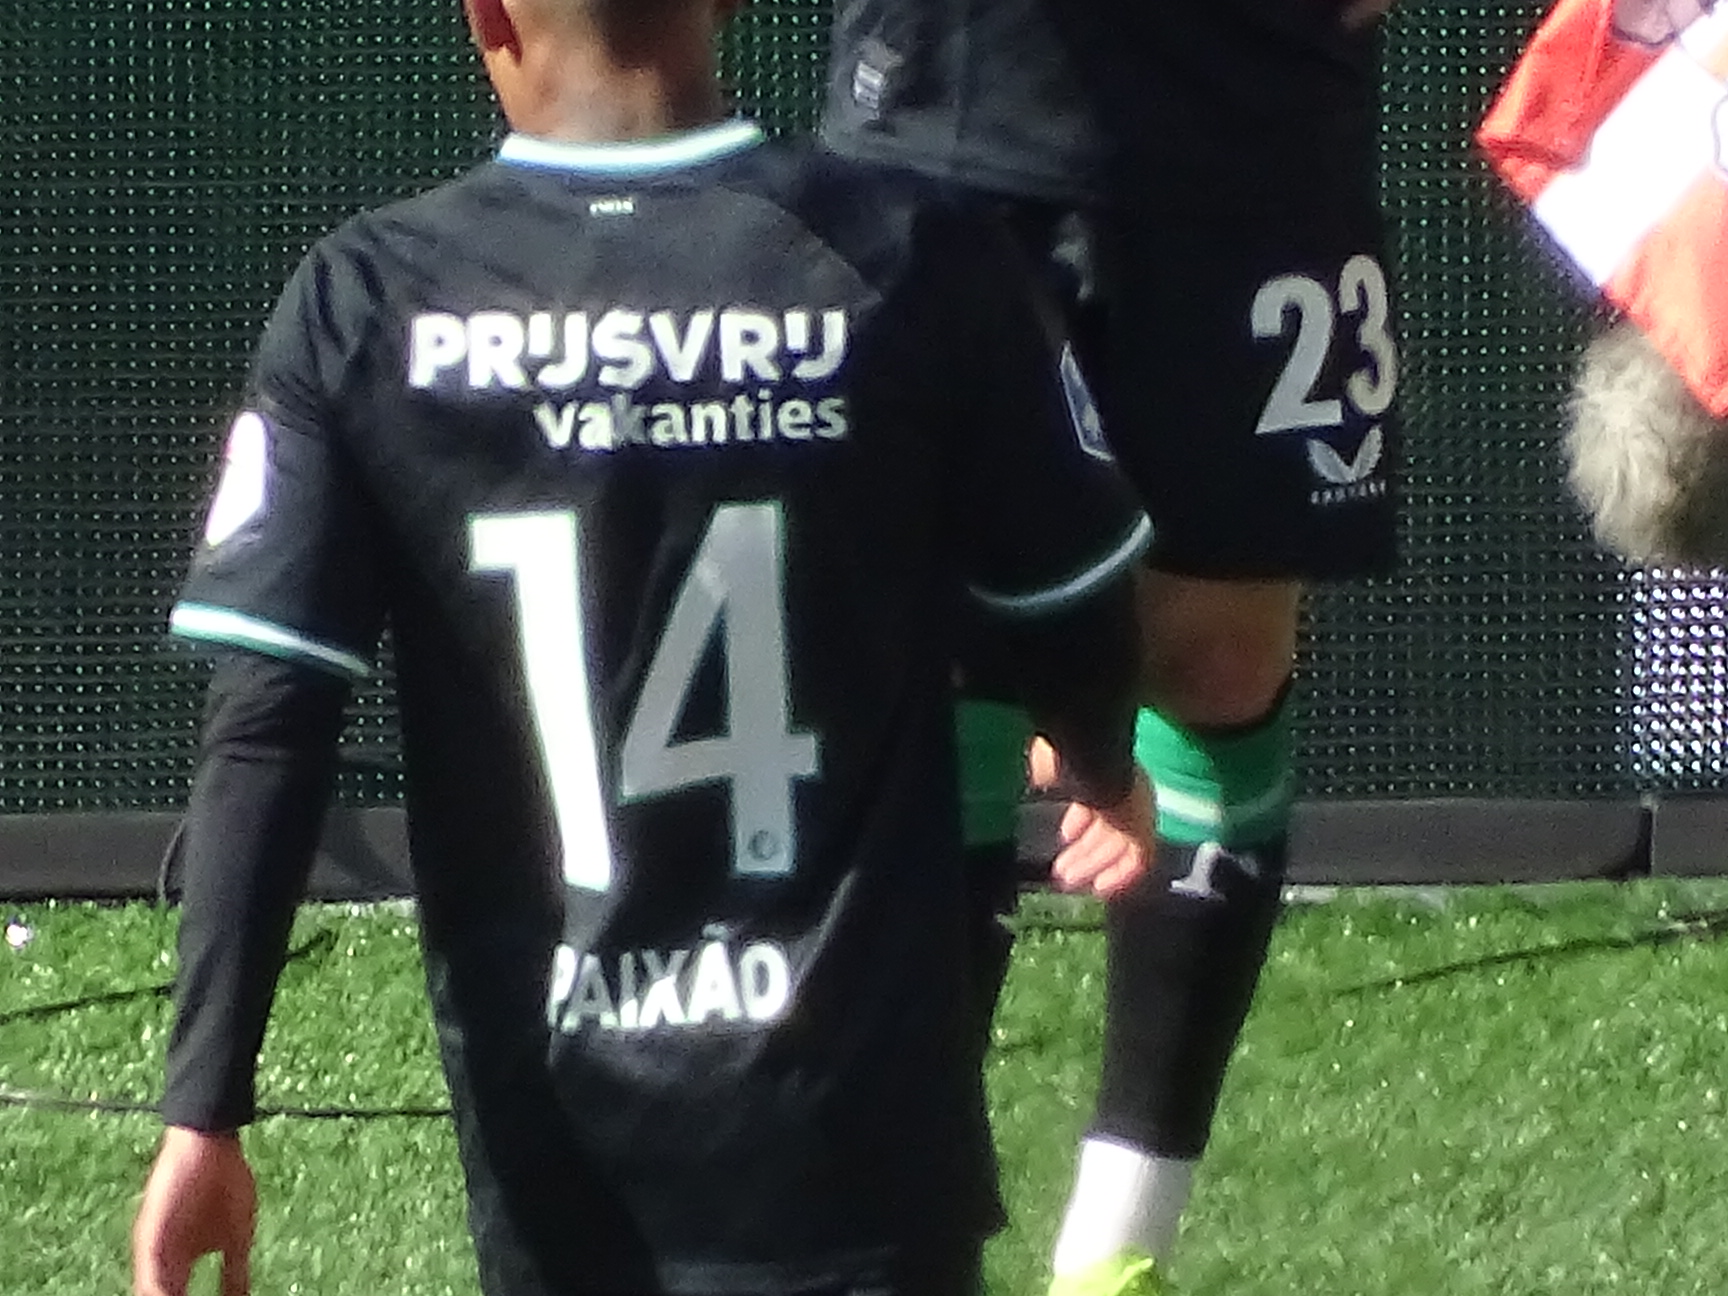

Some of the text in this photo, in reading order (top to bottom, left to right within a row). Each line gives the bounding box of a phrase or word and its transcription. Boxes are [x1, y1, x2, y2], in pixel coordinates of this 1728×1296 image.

[408, 308, 848, 390] PRIJSVRIJ
[1250, 254, 1399, 434] 23
[534, 388, 849, 451] vakanties
[467, 500, 823, 894] 14
